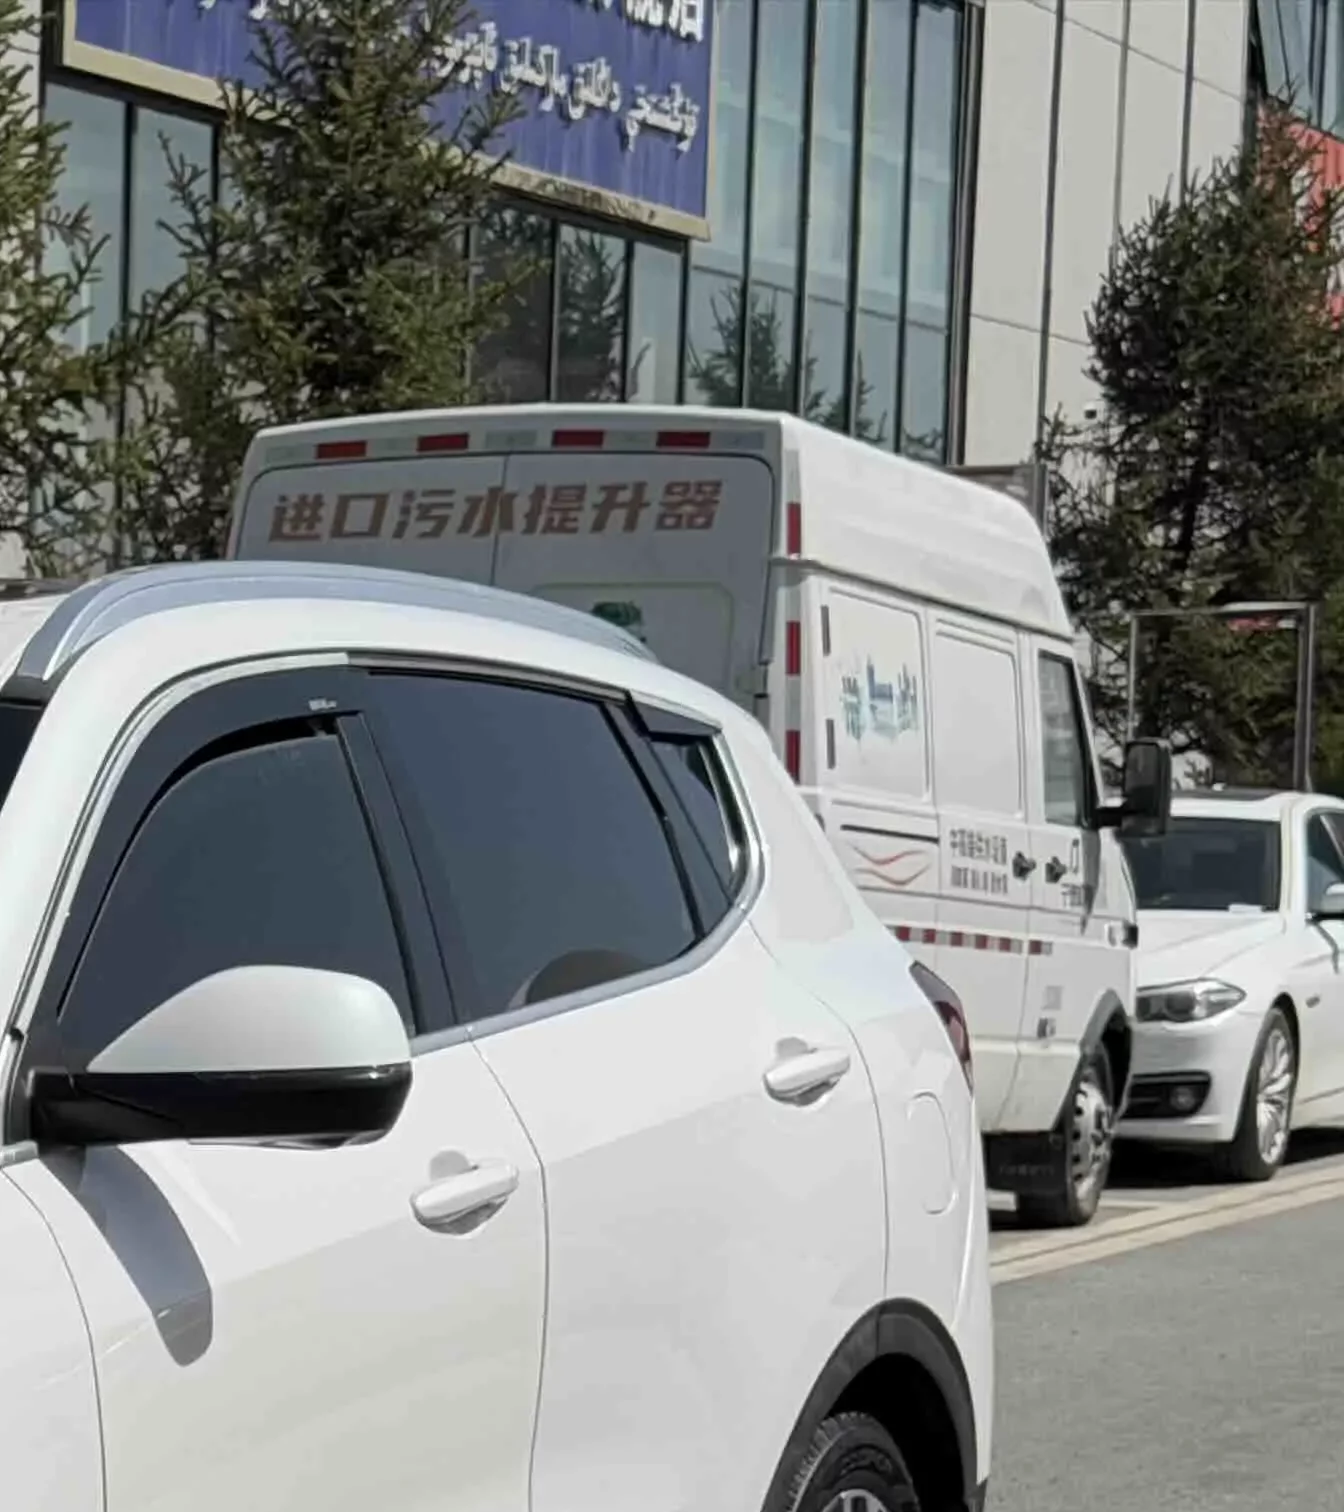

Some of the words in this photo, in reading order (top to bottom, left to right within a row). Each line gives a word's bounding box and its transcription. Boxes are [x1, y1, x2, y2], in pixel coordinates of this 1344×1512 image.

[268, 480, 723, 543] 进口污水提升器
